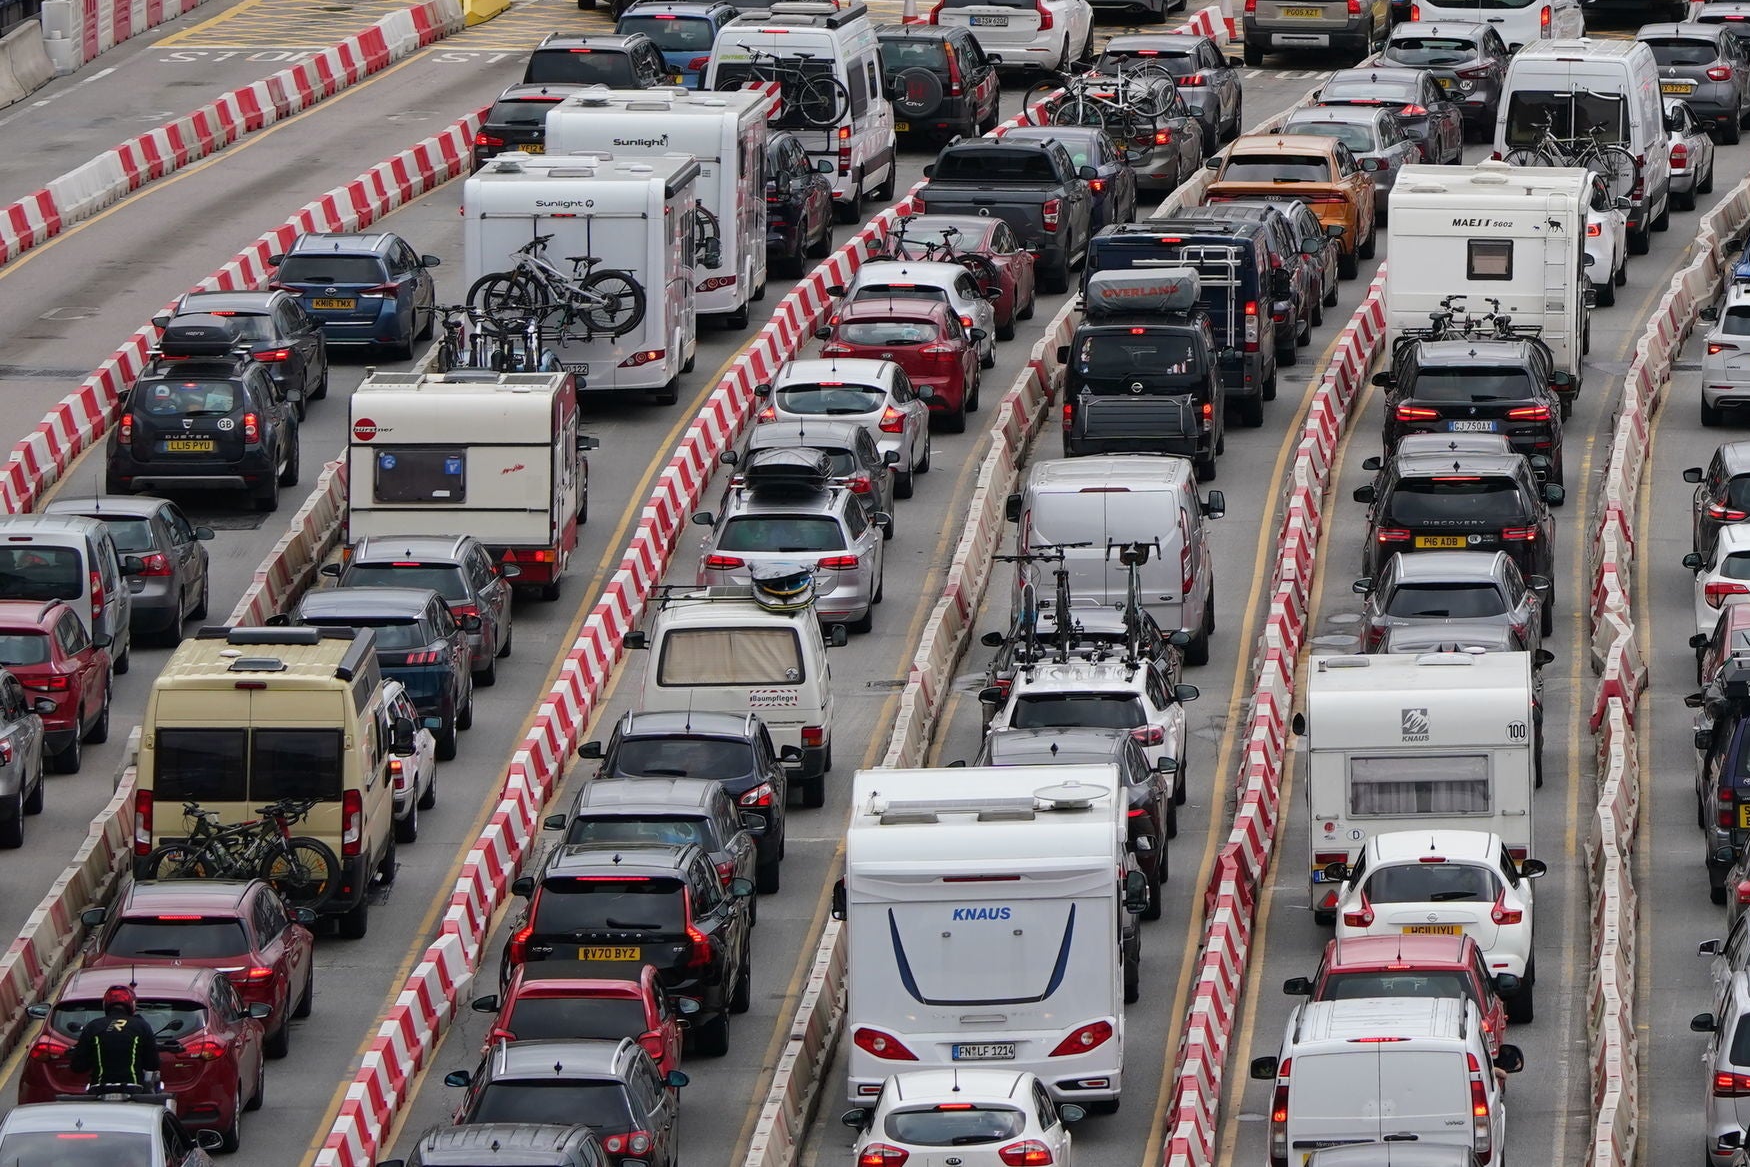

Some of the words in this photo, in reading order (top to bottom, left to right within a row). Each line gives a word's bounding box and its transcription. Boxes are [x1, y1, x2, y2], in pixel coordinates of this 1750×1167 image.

[1461, 80, 1472, 89] UK
[613, 138, 665, 149] Sunlight
[535, 199, 584, 210] Sunlight
[1493, 220, 1513, 229] 5602
[1102, 284, 1180, 300] OVERLAND
[315, 299, 334, 308] KM16
[335, 299, 352, 308] TMX
[219, 420, 232, 430] GB
[170, 441, 192, 451] LL15
[193, 441, 211, 451] PYU
[1440, 537, 1458, 546] ADB
[752, 694, 795, 706] Baumpflege
[1508, 724, 1526, 739] 100
[1402, 735, 1430, 743] KNAUS
[1352, 830, 1360, 840] D
[952, 907, 1012, 921] KNAUS
[584, 948, 612, 960] RV70
[614, 948, 637, 959] BYZ
[959, 1045, 972, 1056] FN
[976, 1046, 990, 1057] LF
[991, 1045, 1014, 1058] 1214
